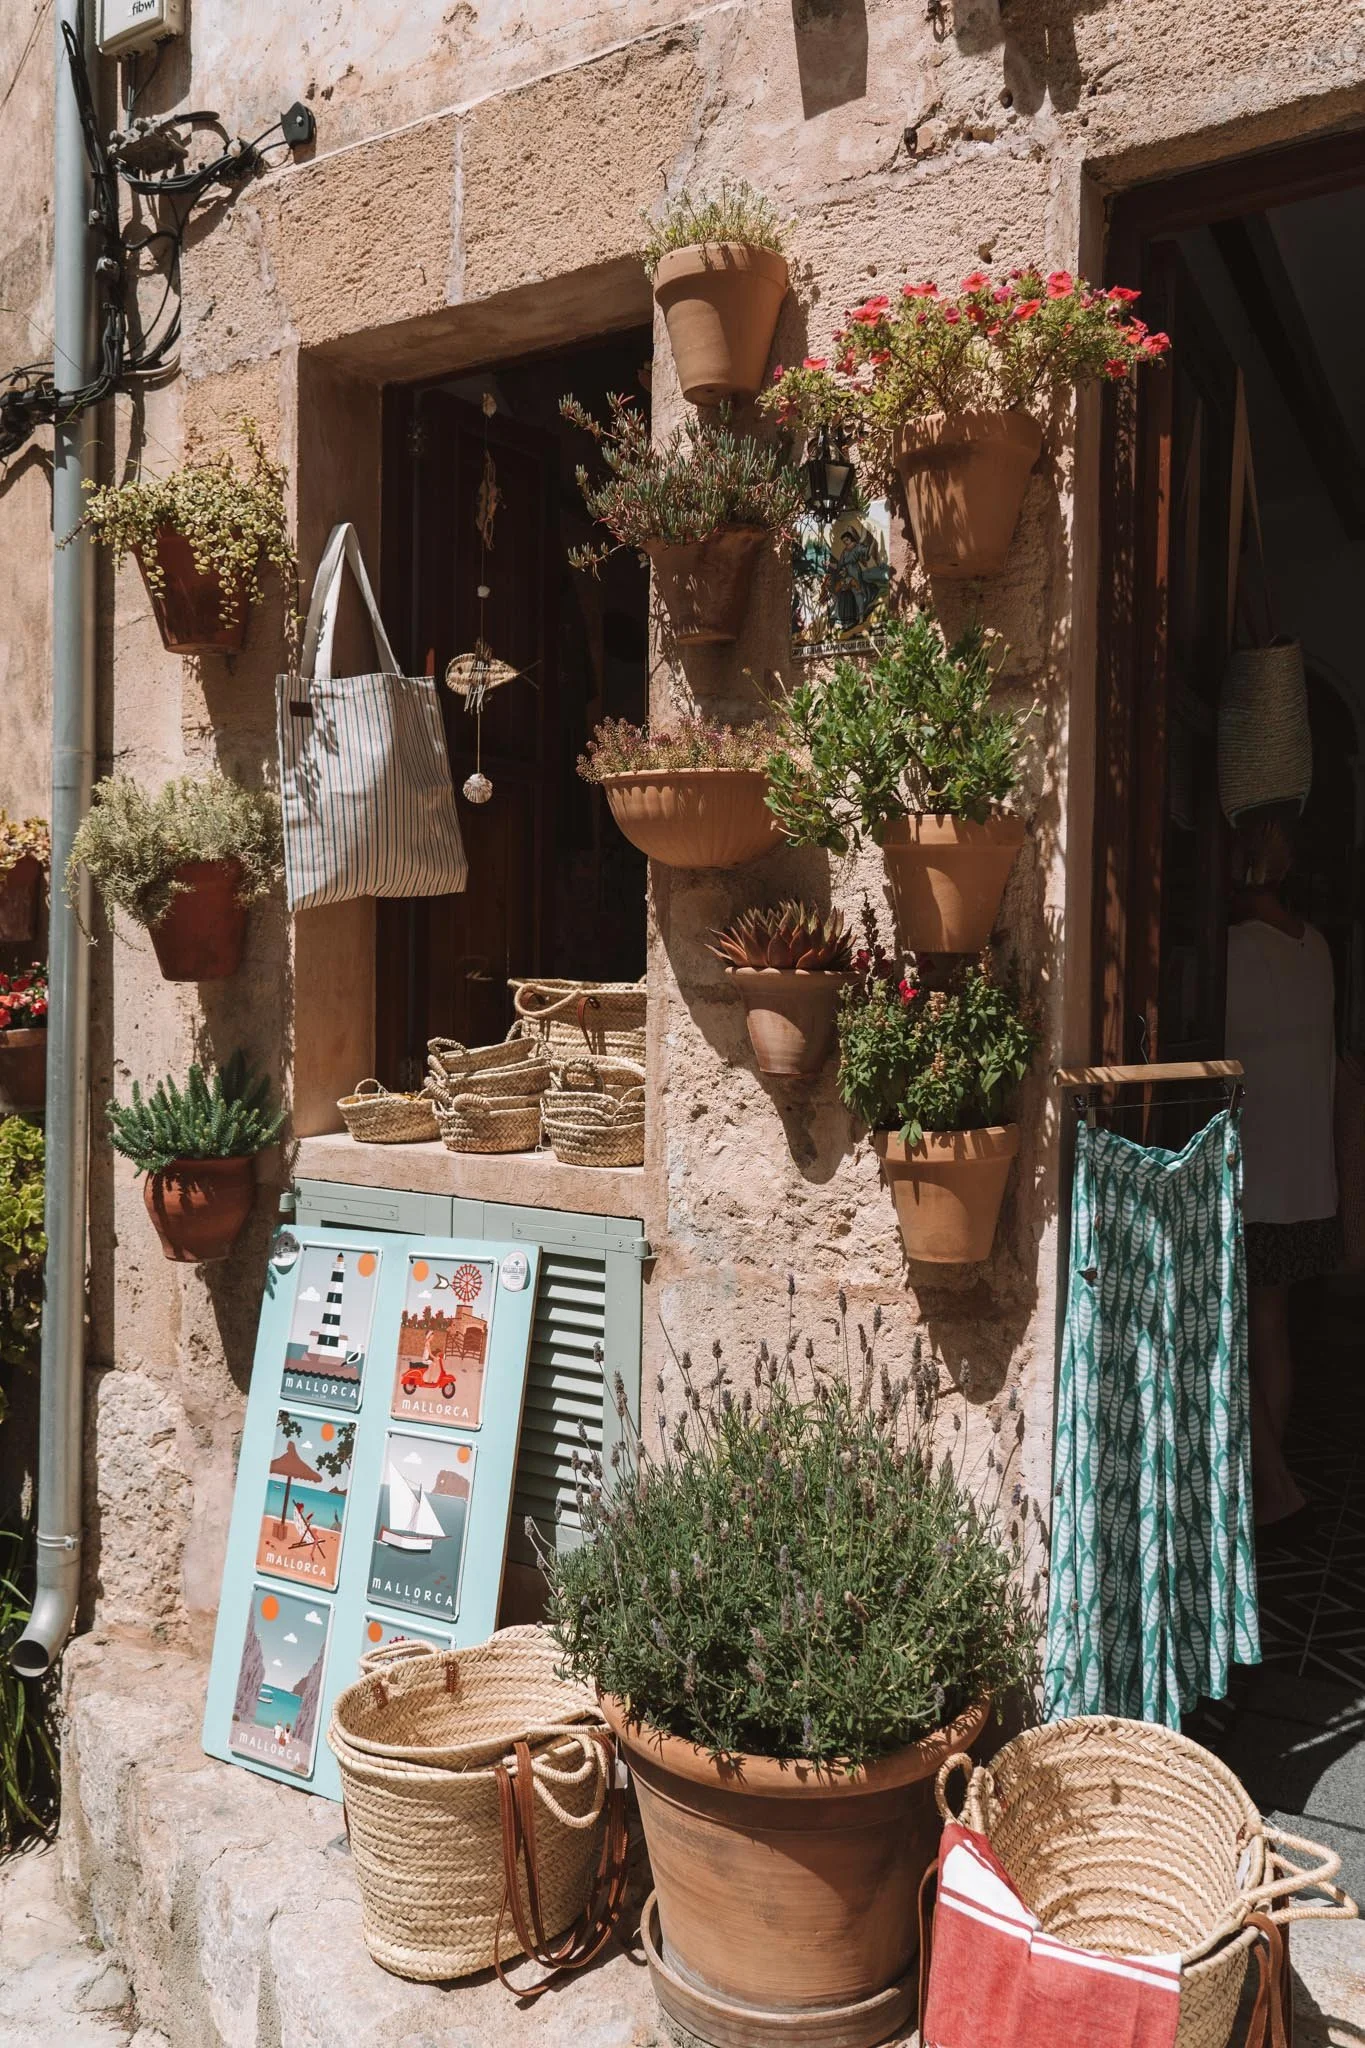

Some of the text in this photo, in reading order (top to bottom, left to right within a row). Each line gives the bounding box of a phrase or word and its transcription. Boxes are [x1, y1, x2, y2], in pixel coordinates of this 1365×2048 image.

[285, 1377, 357, 1398] MALLORCA
[402, 1400, 469, 1418] MALLORCA
[266, 1552, 327, 1576] MALLORCA
[372, 1577, 453, 1606] MALLORCA
[239, 1732, 301, 1763] MALLORCA
